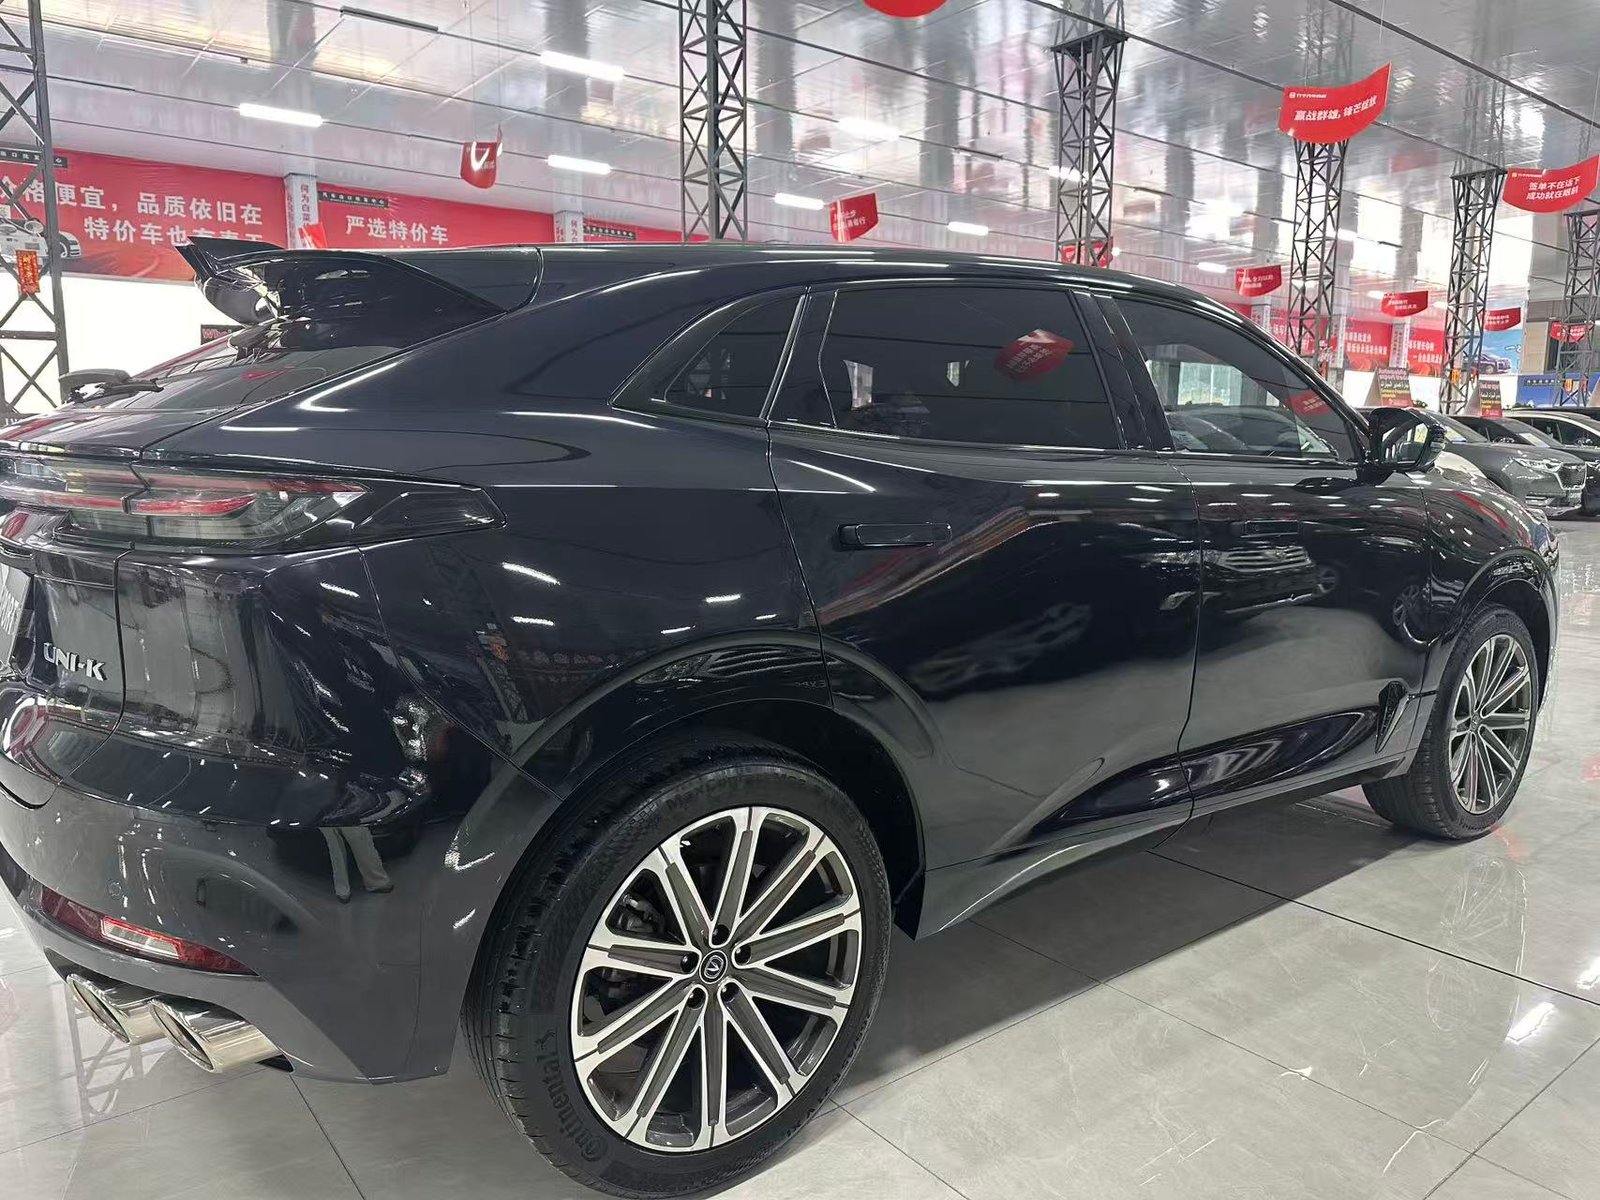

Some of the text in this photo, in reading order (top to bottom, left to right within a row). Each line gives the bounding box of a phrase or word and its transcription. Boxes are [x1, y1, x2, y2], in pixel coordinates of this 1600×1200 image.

[345, 215, 449, 245] 严选特价车
[43, 642, 107, 682] UNI-K
